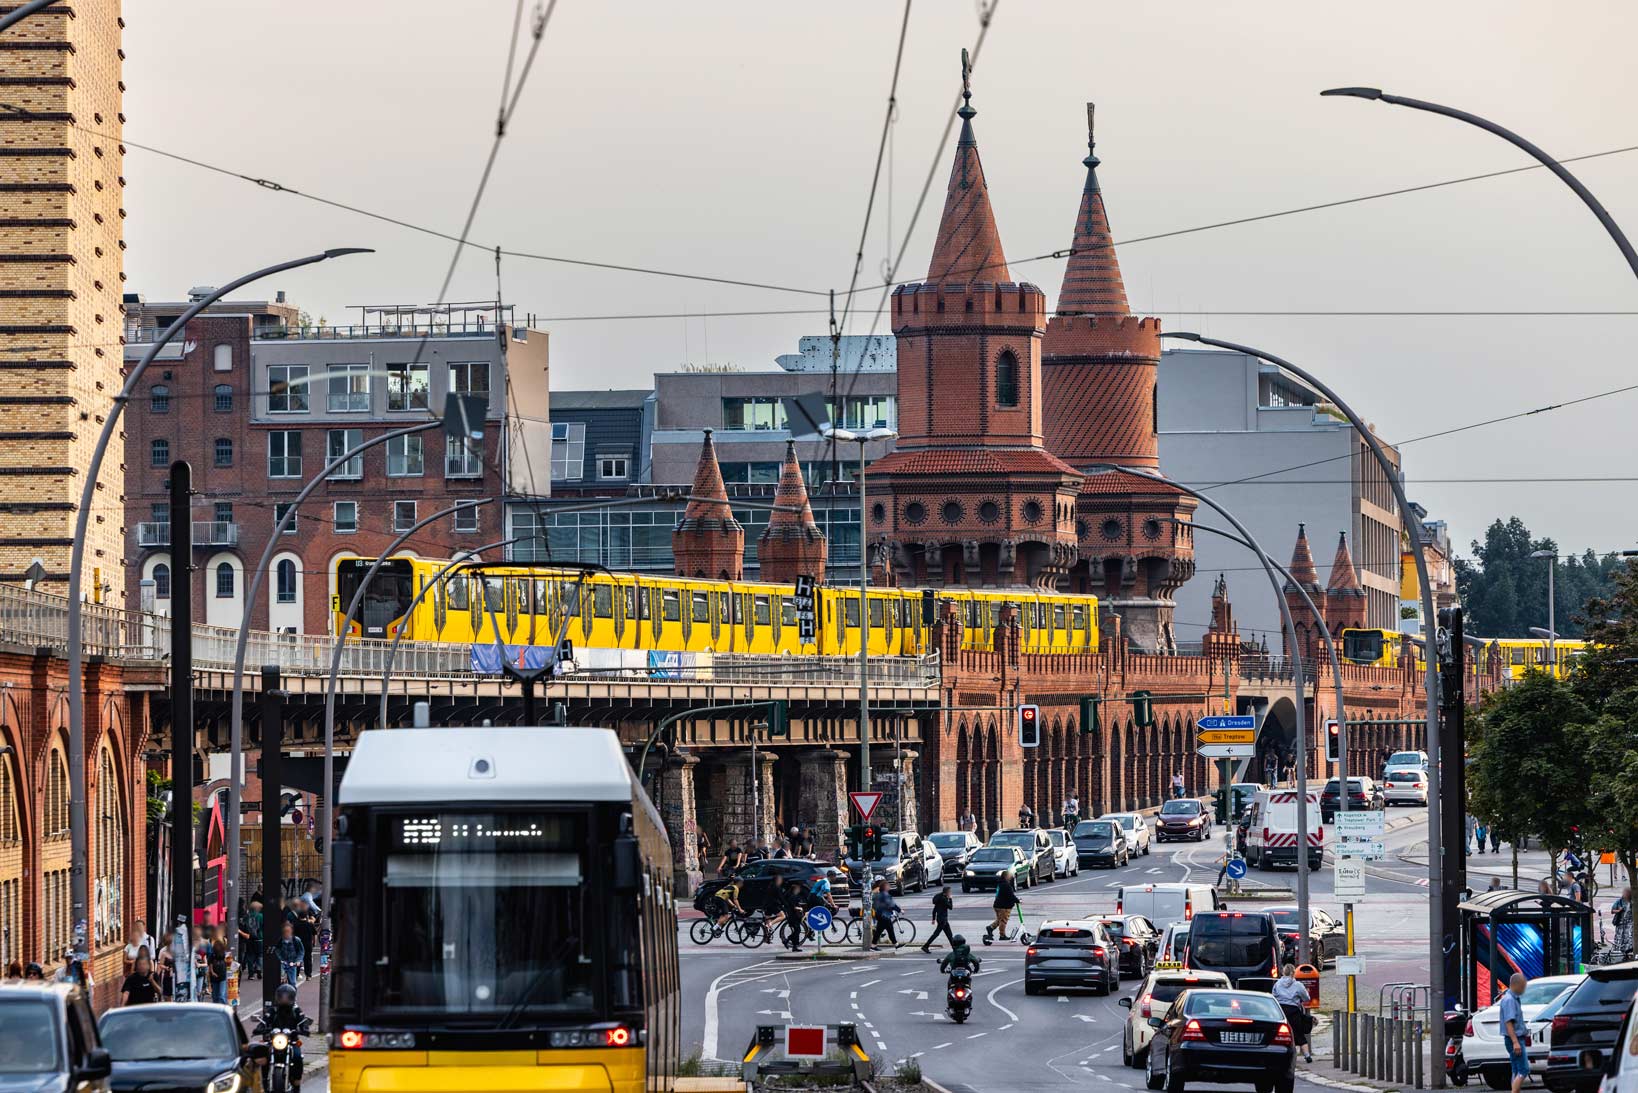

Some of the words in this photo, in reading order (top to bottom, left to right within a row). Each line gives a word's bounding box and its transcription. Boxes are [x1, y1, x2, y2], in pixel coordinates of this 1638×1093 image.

[797, 577, 811, 596] H
[333, 597, 339, 609] F
[802, 620, 813, 635] H
